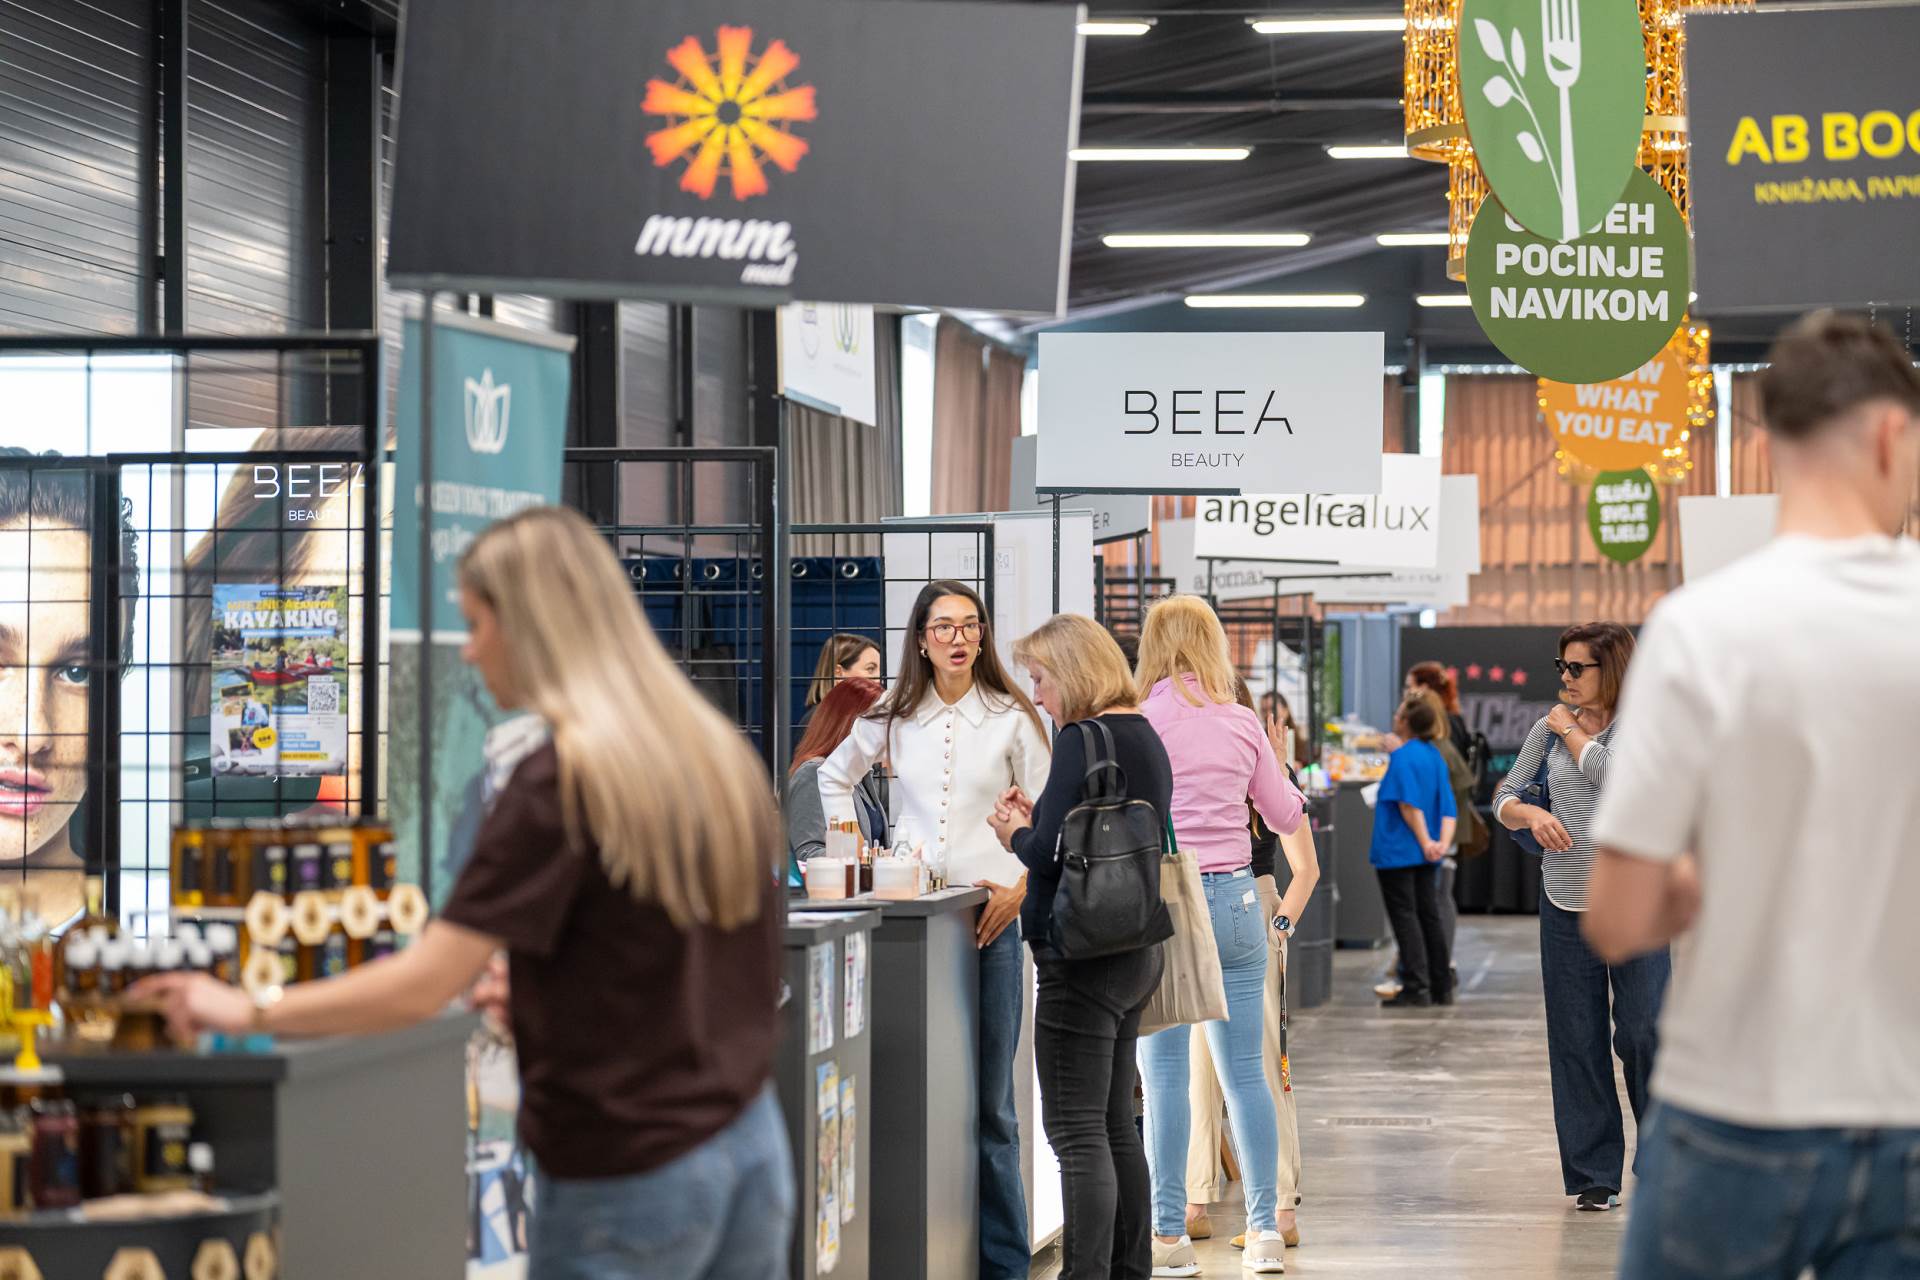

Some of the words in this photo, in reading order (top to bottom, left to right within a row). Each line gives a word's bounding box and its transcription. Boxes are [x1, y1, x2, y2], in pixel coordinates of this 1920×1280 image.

[1726, 114, 1810, 165] AB
[1490, 286, 1668, 321] NAVIKOM
[1124, 390, 1293, 435] BEEA
[1575, 384, 1660, 414] WHAT
[1555, 411, 1614, 439] YOU
[1617, 418, 1673, 446] EAT
[1171, 452, 1245, 468] BEAUTY
[223, 609, 339, 629] KAYAKING
